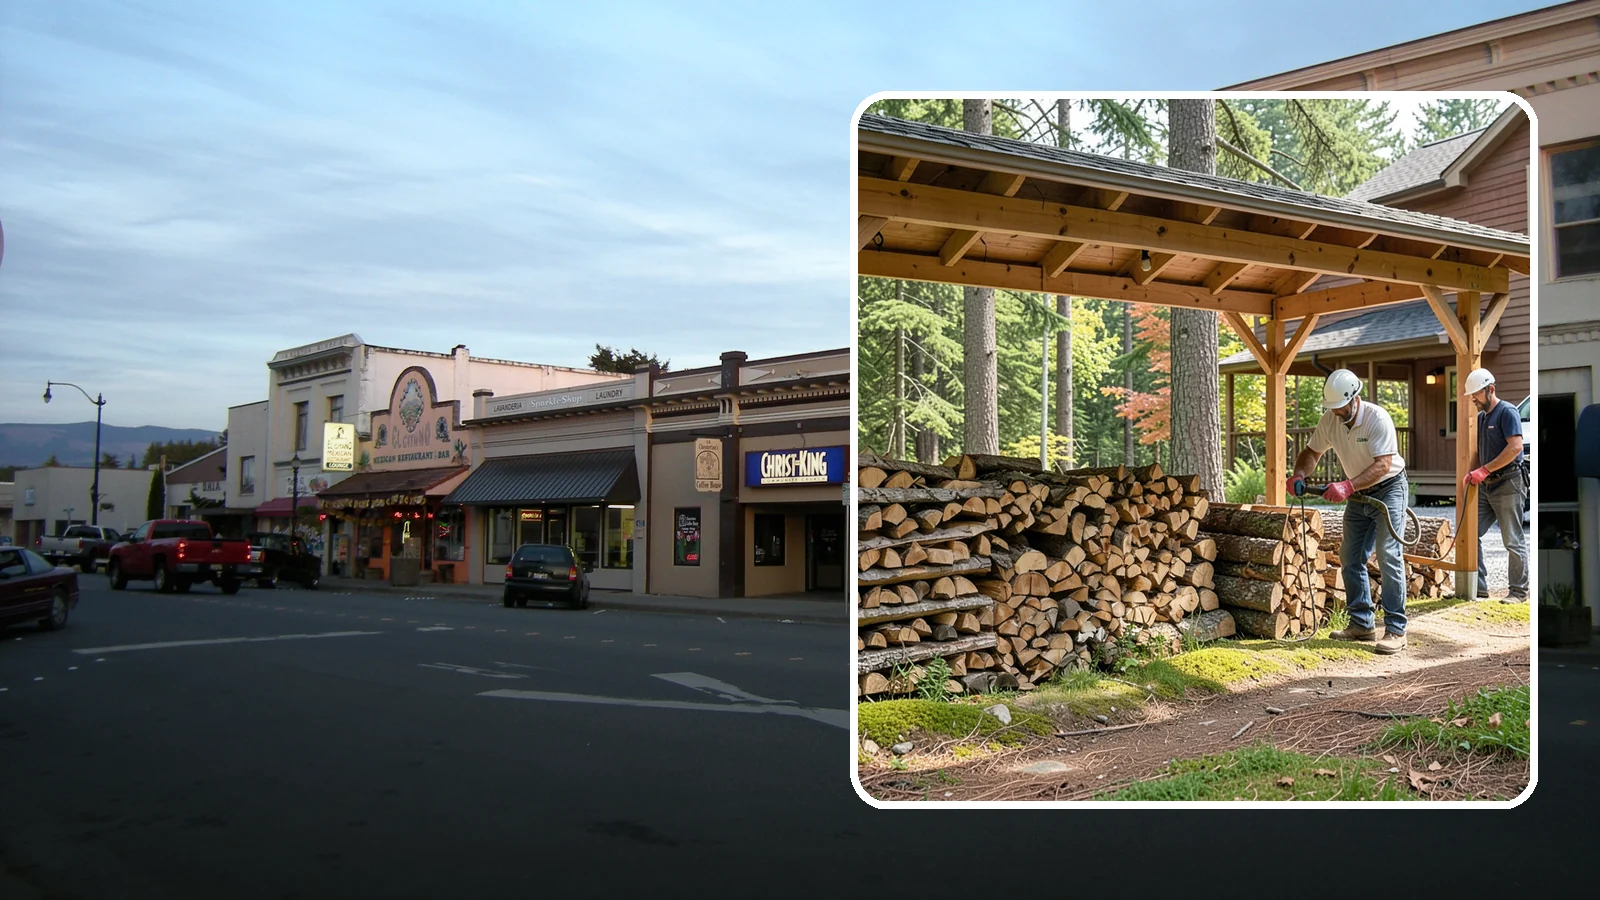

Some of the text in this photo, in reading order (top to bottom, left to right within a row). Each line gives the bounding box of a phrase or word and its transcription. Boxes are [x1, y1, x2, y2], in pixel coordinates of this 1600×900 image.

[561, 394, 582, 405] Shop
[595, 389, 623, 400] LAUNDRY
[493, 402, 522, 413] LAVANDERIA
[397, 451, 433, 462] RESTAURANT
[438, 450, 450, 459] BAR
[761, 450, 827, 478] CHRIST KING
